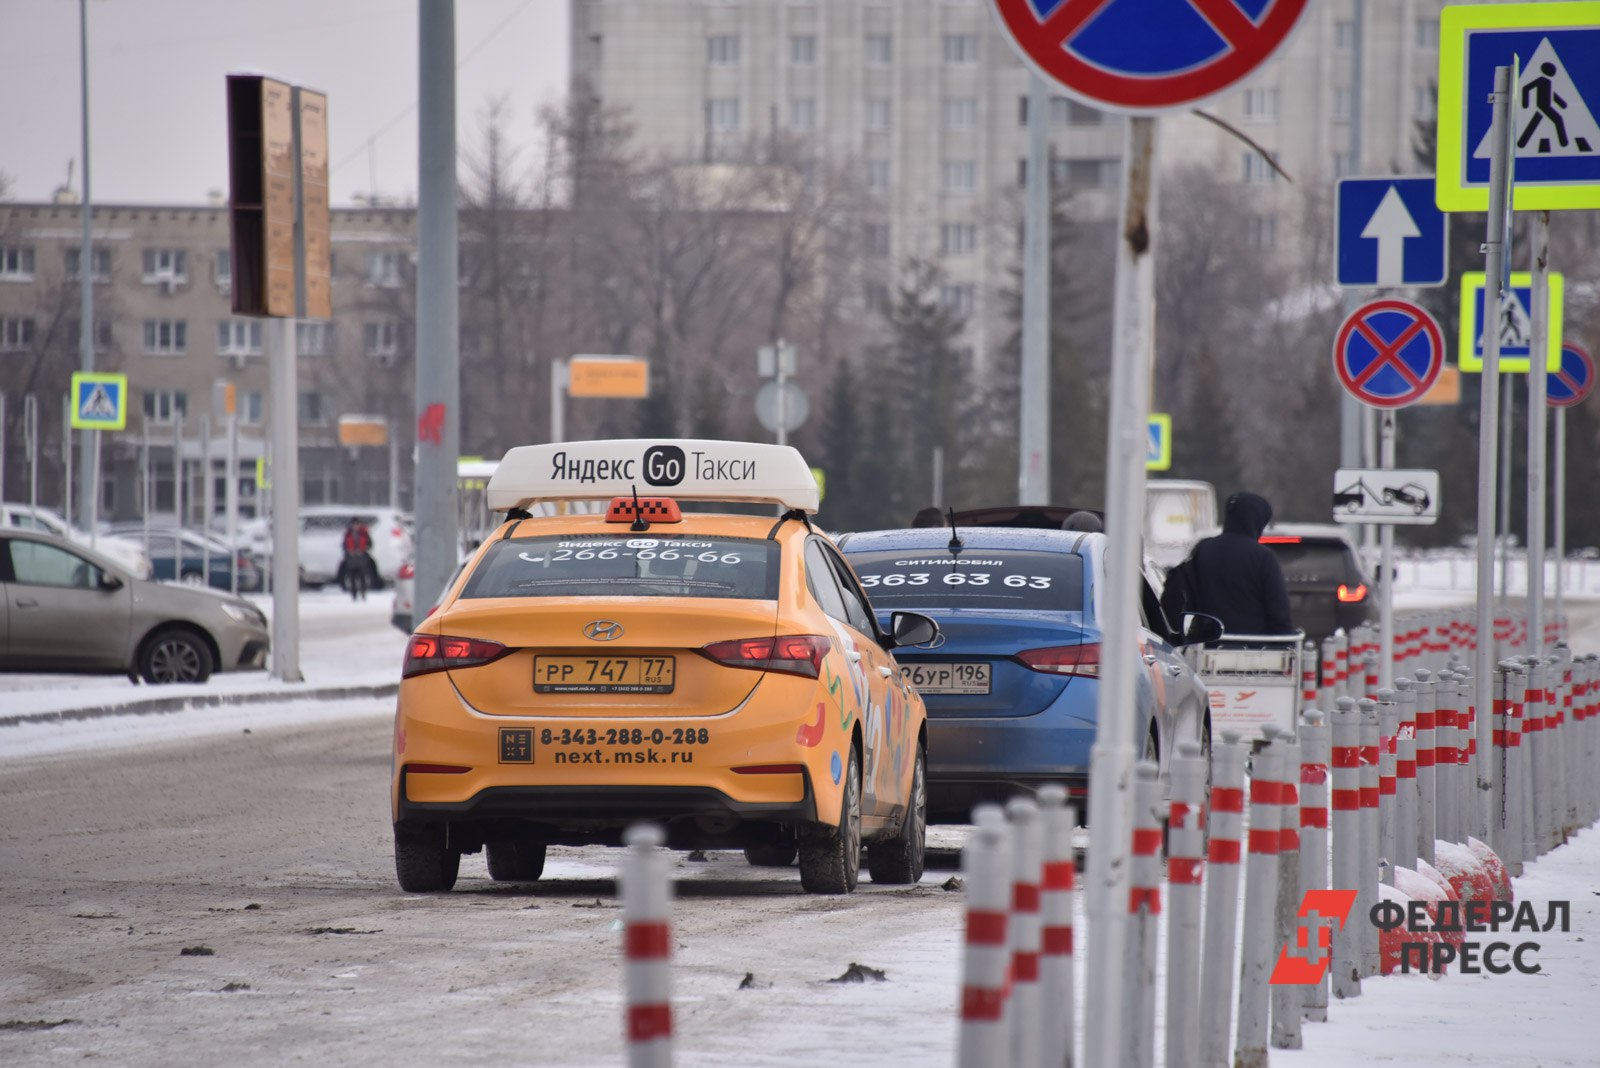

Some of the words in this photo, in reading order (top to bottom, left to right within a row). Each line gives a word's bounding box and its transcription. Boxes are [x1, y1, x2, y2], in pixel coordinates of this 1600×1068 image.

[551, 452, 635, 484] Яндекс
[648, 451, 680, 480] Go
[691, 452, 756, 481] Такси
[664, 540, 713, 548] Такси
[552, 549, 741, 564] 266-66-66
[861, 573, 930, 588] 363
[943, 573, 990, 586] 63
[1004, 574, 1051, 589] 63
[586, 661, 628, 681] 747
[644, 660, 665, 675] 77
[955, 665, 985, 680] 196
[541, 728, 709, 745] 8-343-288-0-288
[555, 748, 693, 764] next.msk.ru
